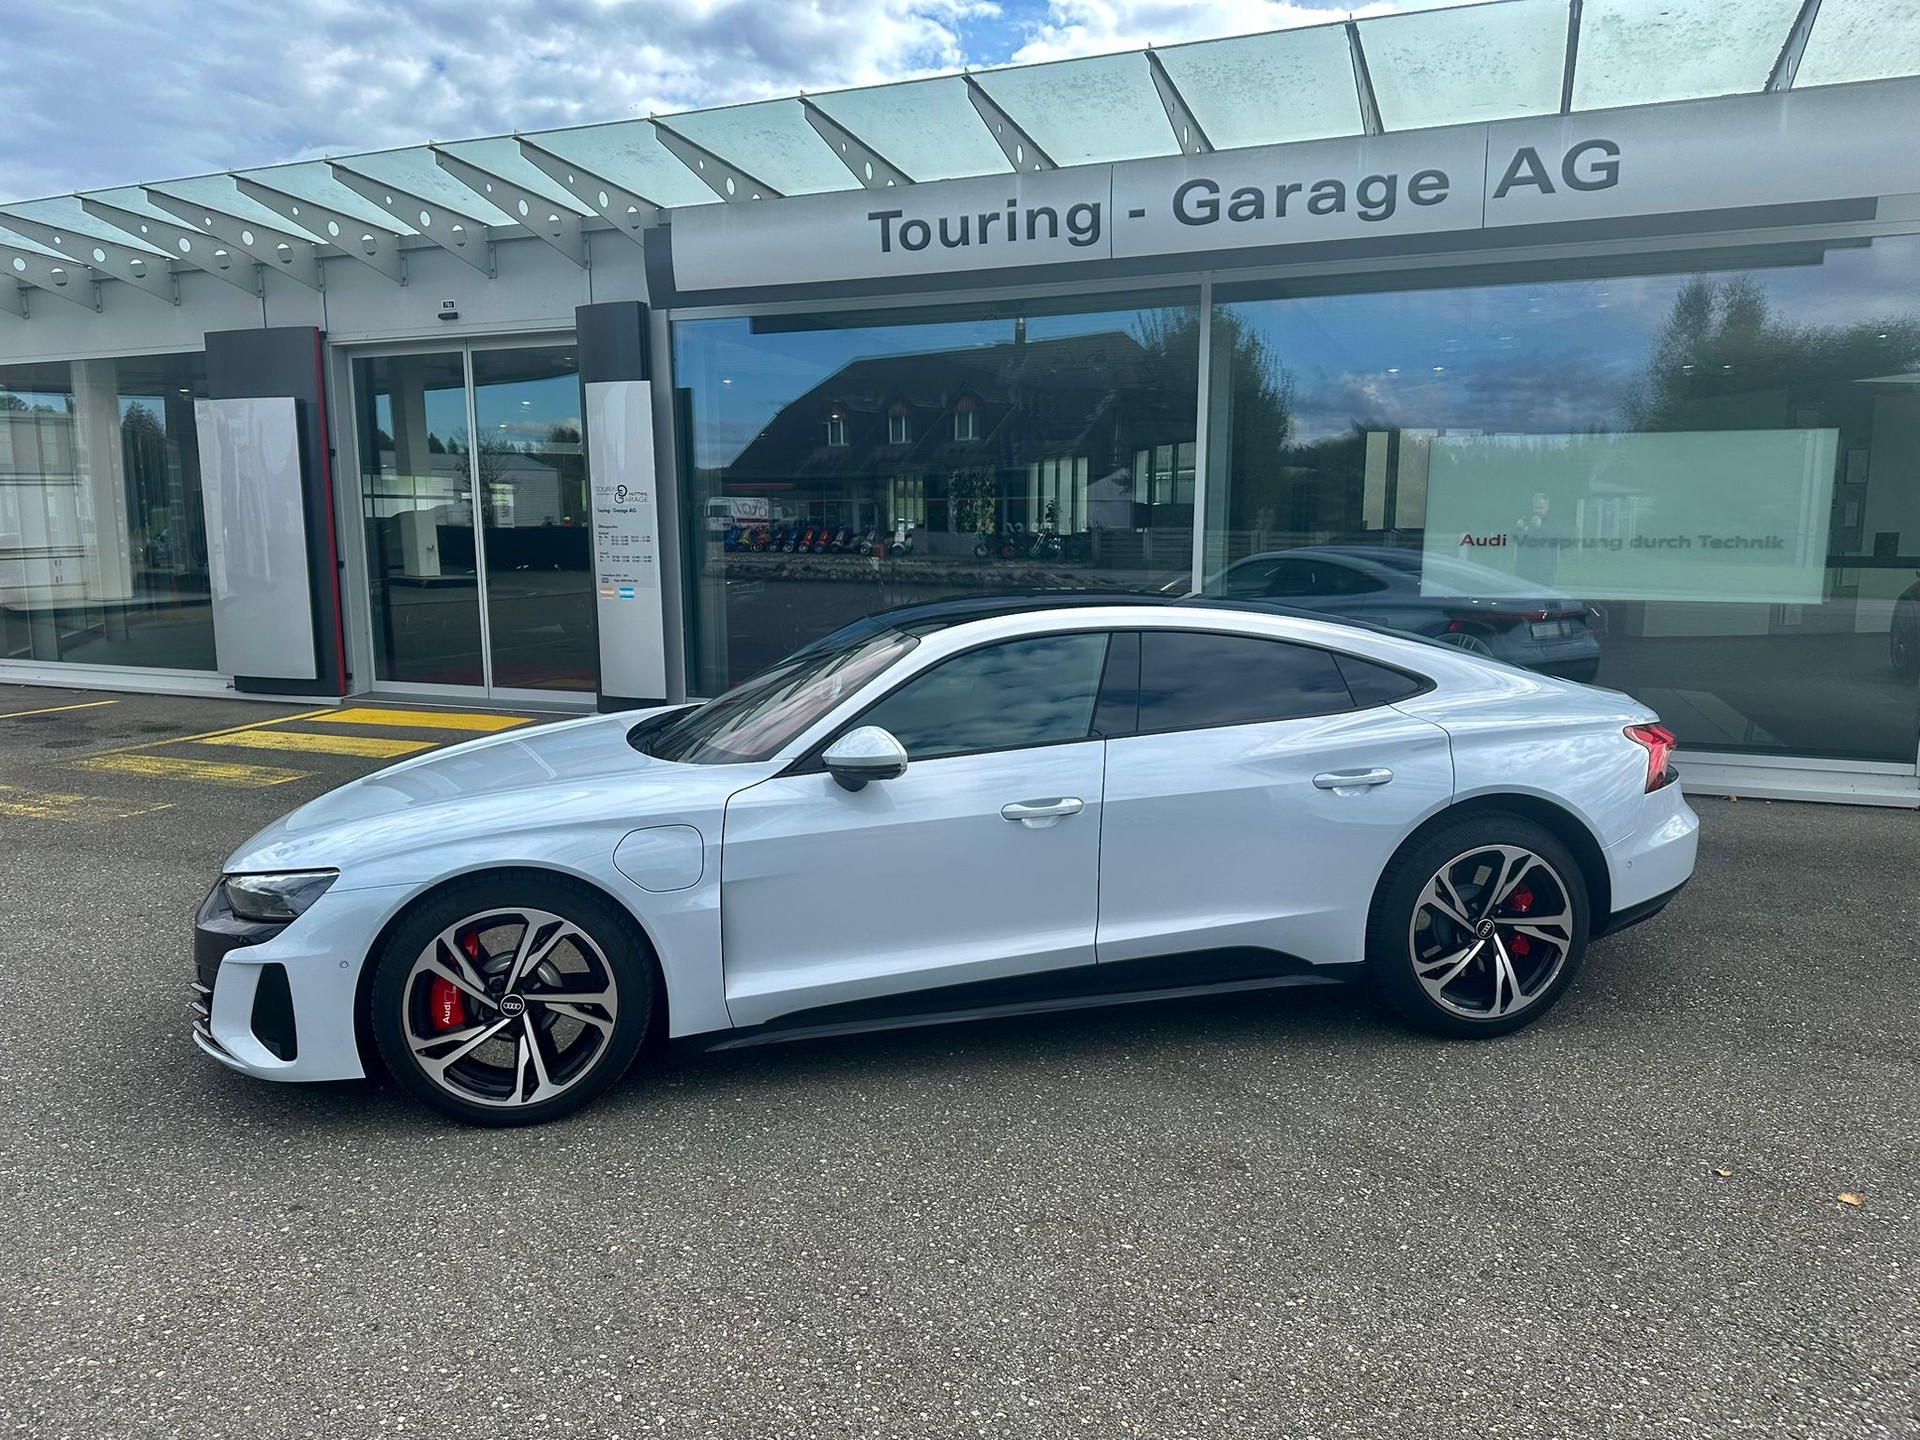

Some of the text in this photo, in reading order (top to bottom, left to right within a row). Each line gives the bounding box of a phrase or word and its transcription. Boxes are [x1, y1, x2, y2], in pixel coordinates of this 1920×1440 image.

[868, 138, 1621, 253] Touring - Garage AG
[1460, 533, 1784, 551] Audi Vorsprung durch Technik
[442, 1001, 451, 1024] Audi
